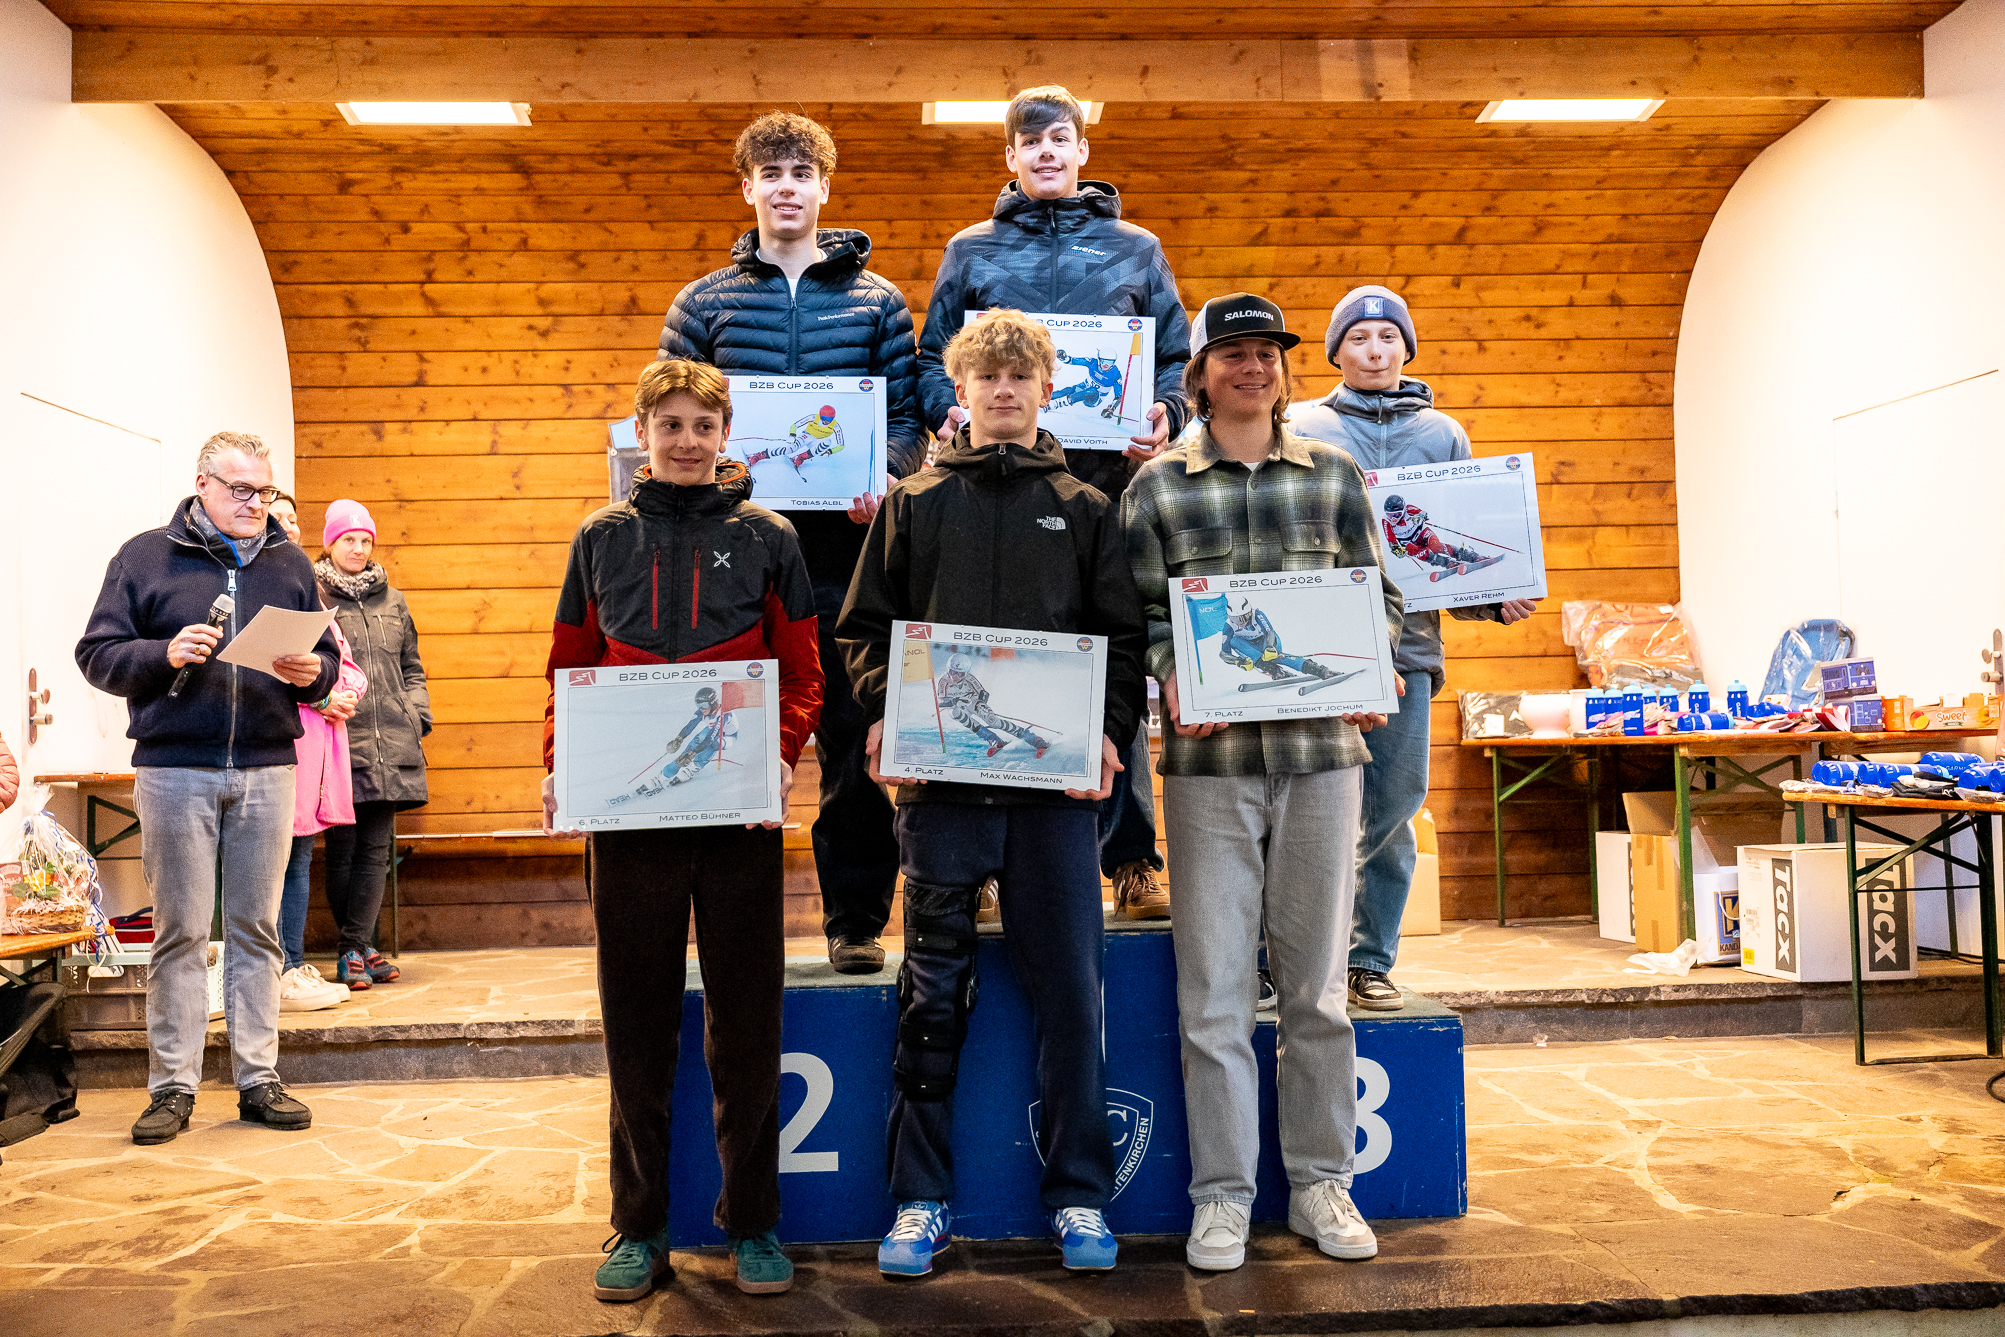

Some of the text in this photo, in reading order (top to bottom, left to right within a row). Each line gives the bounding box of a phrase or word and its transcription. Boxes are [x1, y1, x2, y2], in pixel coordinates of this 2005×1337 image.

[1224, 309, 1274, 321] SALOMON
[1072, 320, 1102, 329] 2026
[749, 381, 775, 389] BZB
[803, 382, 834, 390] 2026
[1397, 471, 1423, 481] BZB
[1451, 465, 1481, 475] 2026
[1229, 579, 1258, 588] BZB
[1289, 575, 1323, 585] 2026
[1453, 594, 1480, 603] XAVER
[953, 631, 982, 641] BZB
[1014, 636, 1048, 647] 2026
[619, 672, 648, 682] BZB
[682, 669, 717, 679] 2026
[1214, 710, 1243, 718] PLATZ
[1277, 704, 1363, 714] BENEDIKT JOCHUM
[1936, 711, 1967, 722] Sweet
[915, 767, 944, 776] PLATZ
[980, 771, 1063, 784] MAX WACHSMANN
[590, 818, 620, 826] PLATZ
[659, 812, 741, 822] MATTEO BÜHNER
[1774, 865, 1791, 965] Tacx
[1871, 864, 1901, 964] Tacx
[778, 1052, 839, 1173] 2
[1353, 1056, 1392, 1174] 3
